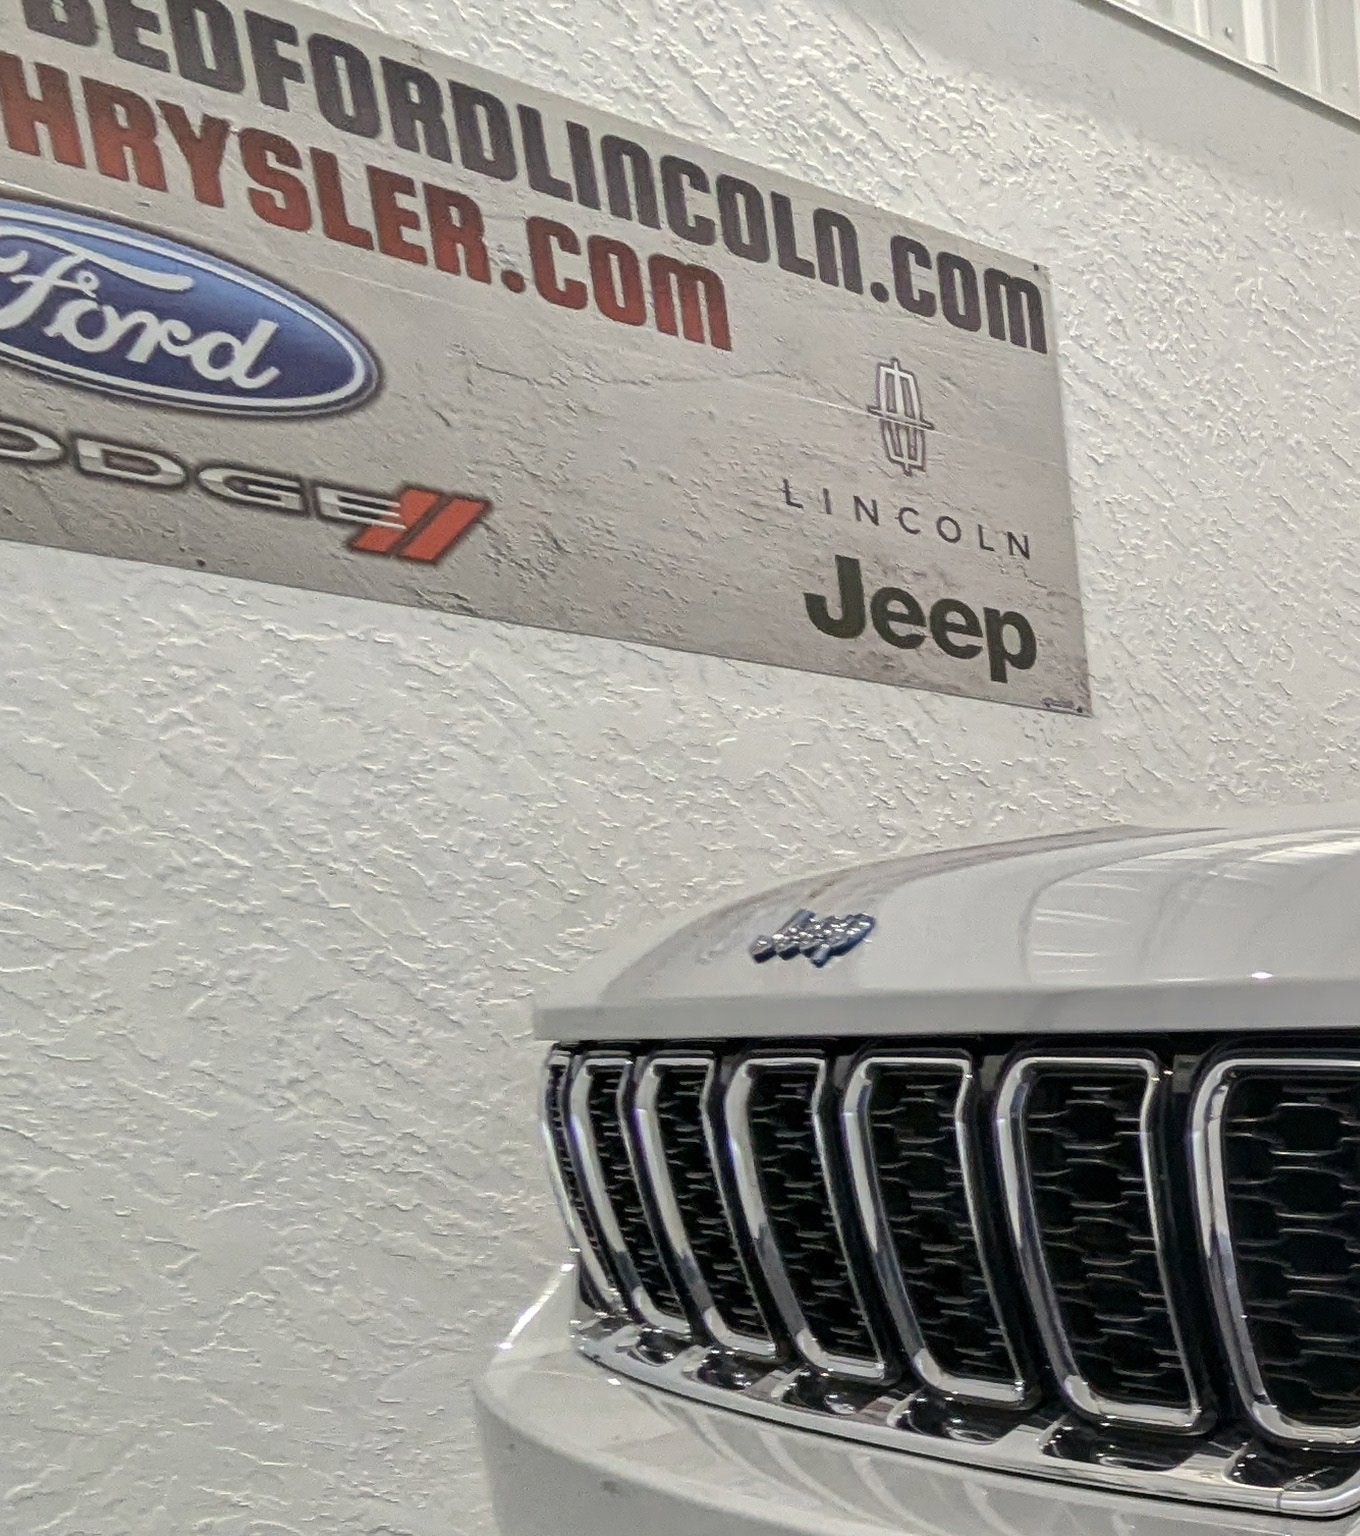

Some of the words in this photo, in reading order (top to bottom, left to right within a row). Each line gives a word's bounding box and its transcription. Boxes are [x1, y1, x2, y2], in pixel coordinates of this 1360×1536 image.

[0, 226, 281, 389] Ford
[782, 477, 1031, 561] LINCOLN
[803, 554, 1037, 683] Jeep
